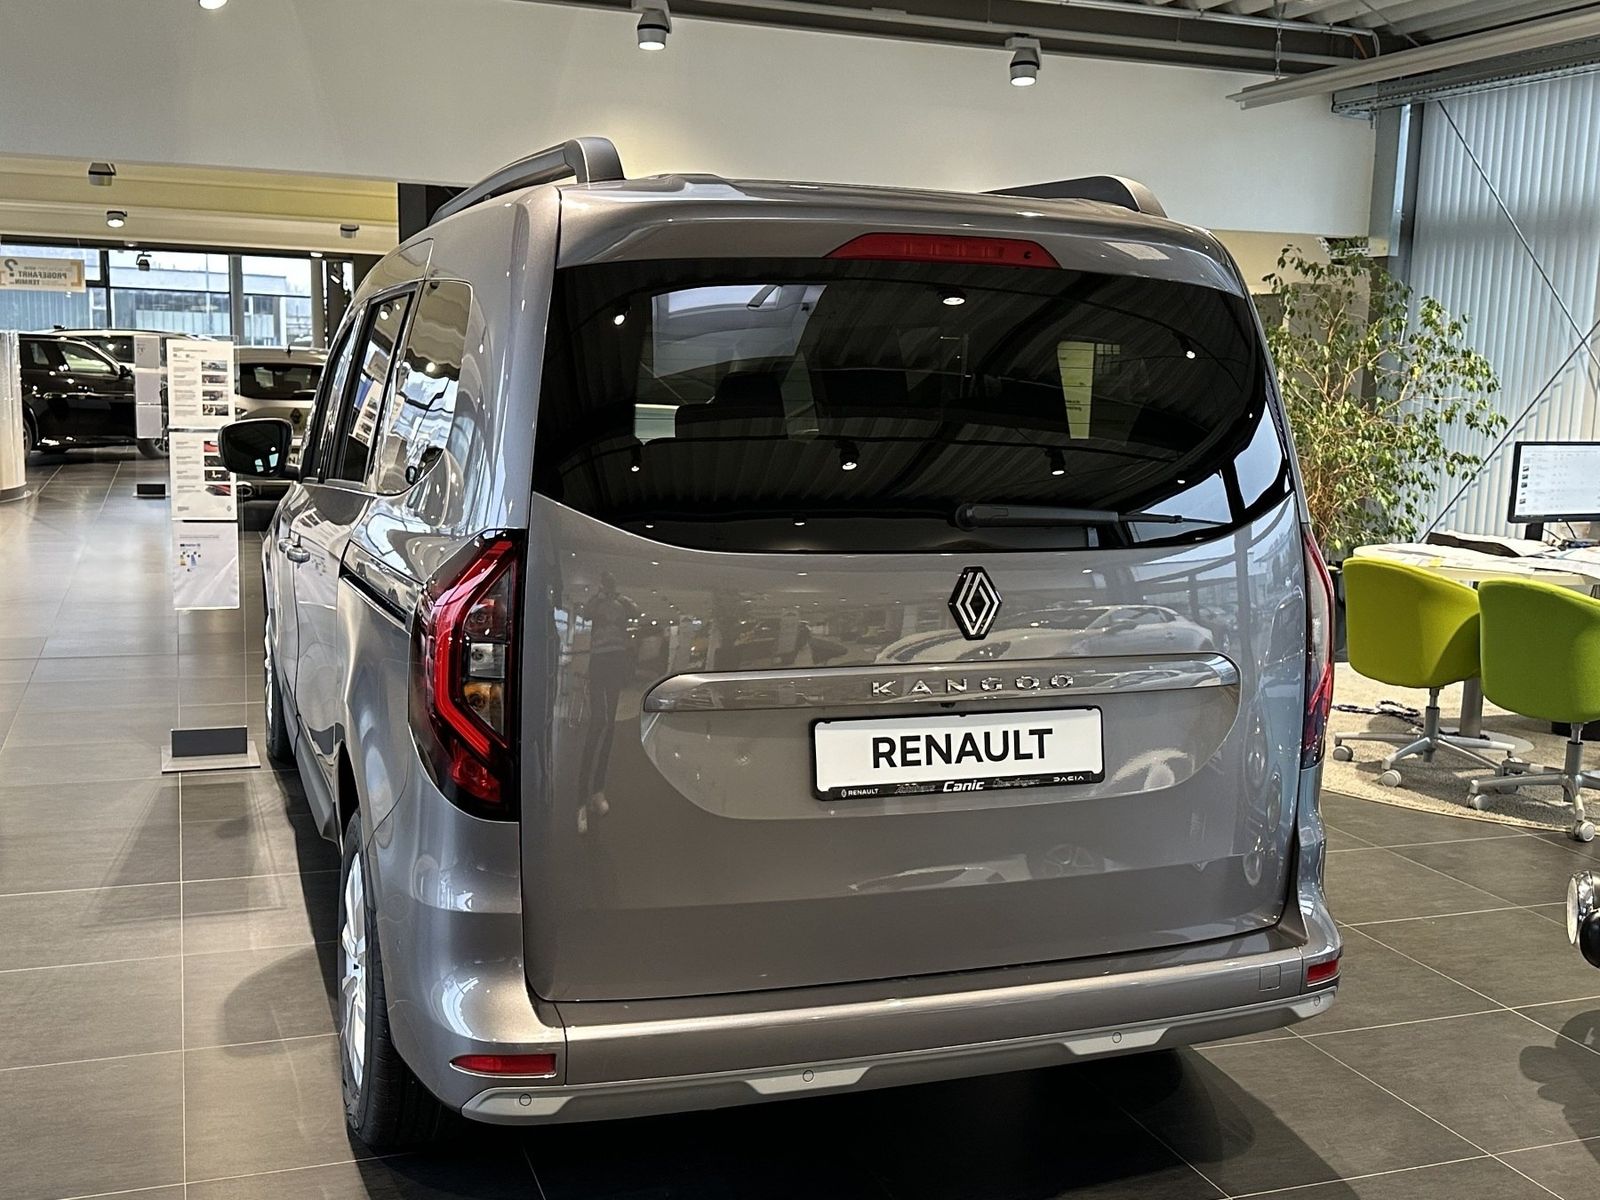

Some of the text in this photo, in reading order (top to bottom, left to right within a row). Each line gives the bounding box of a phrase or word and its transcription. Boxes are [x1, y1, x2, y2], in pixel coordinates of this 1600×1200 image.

[871, 674, 1074, 697] KANGOO
[872, 728, 1053, 769] RENAULT
[847, 788, 879, 796] RENAULT
[943, 780, 985, 792] Canic
